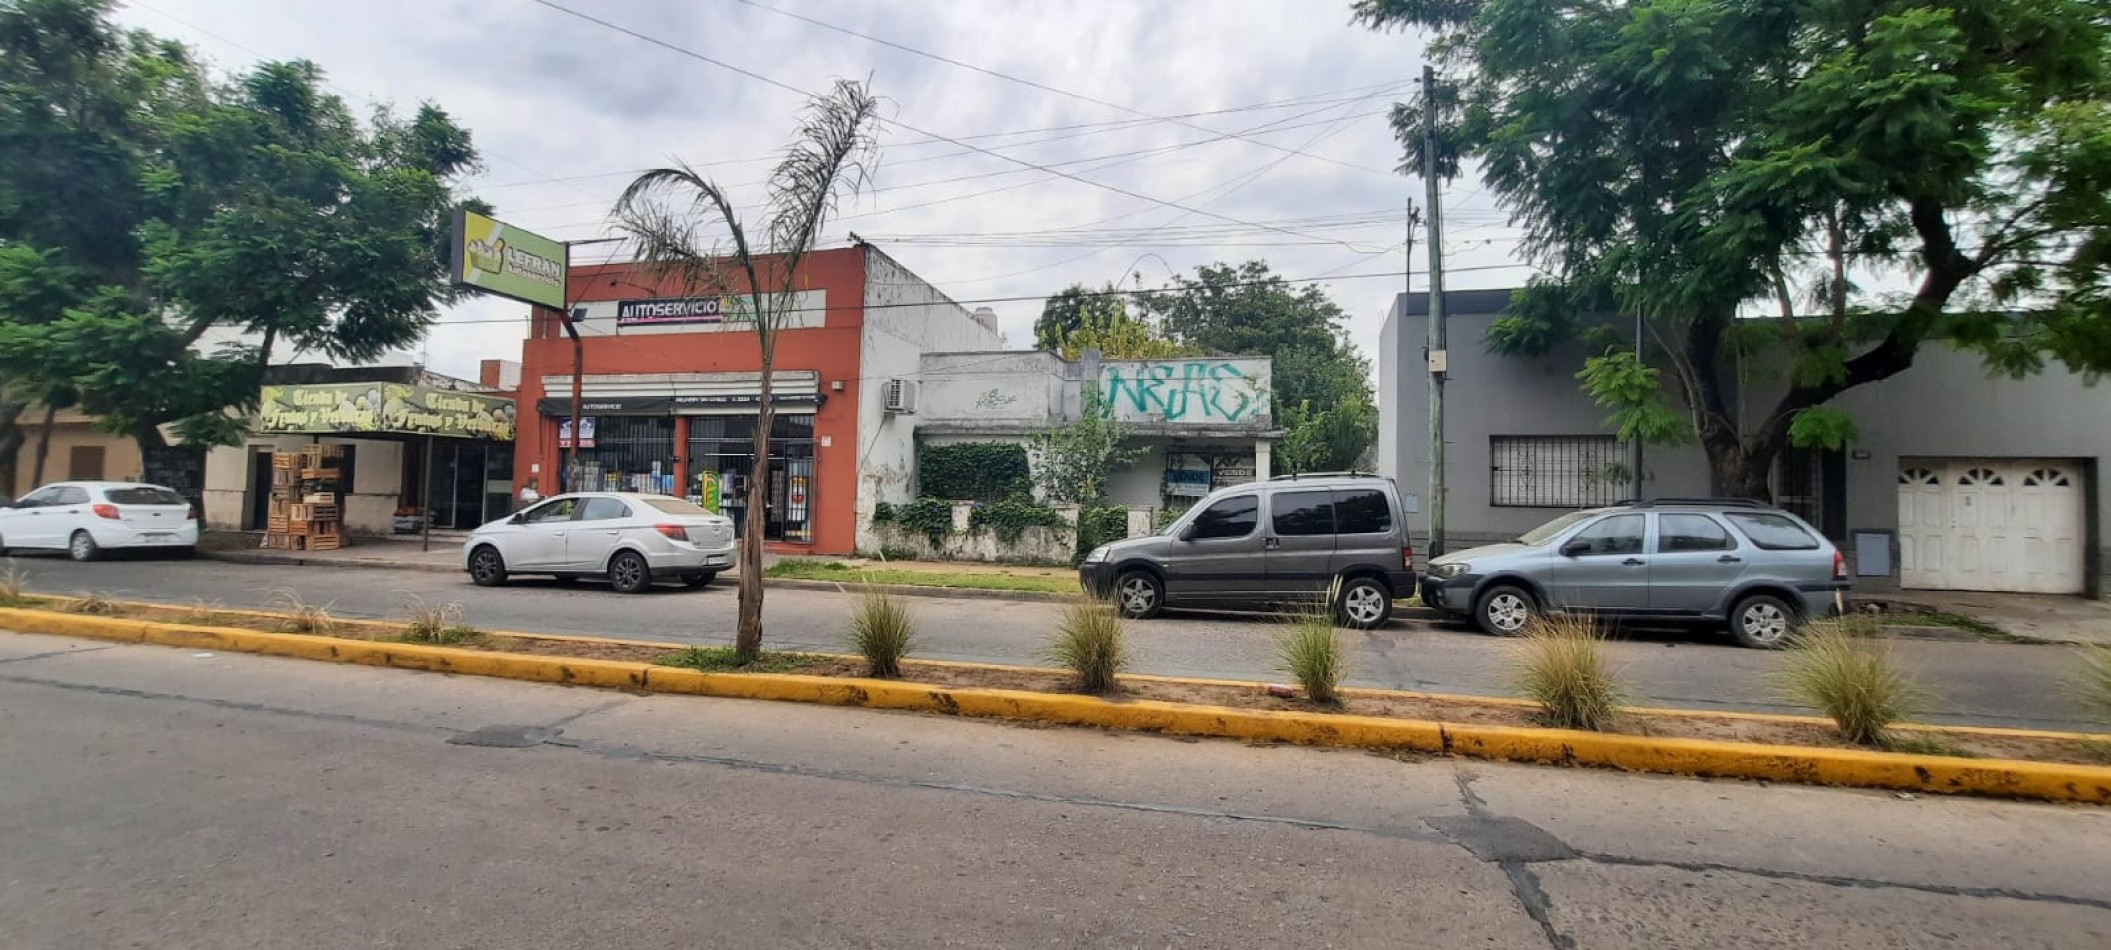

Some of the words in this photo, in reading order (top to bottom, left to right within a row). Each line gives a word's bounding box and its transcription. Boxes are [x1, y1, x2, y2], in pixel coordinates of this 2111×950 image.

[506, 246, 562, 276] LEFRAN
[621, 301, 718, 320] AUTOSERVICIO
[425, 392, 469, 413] Tienda
